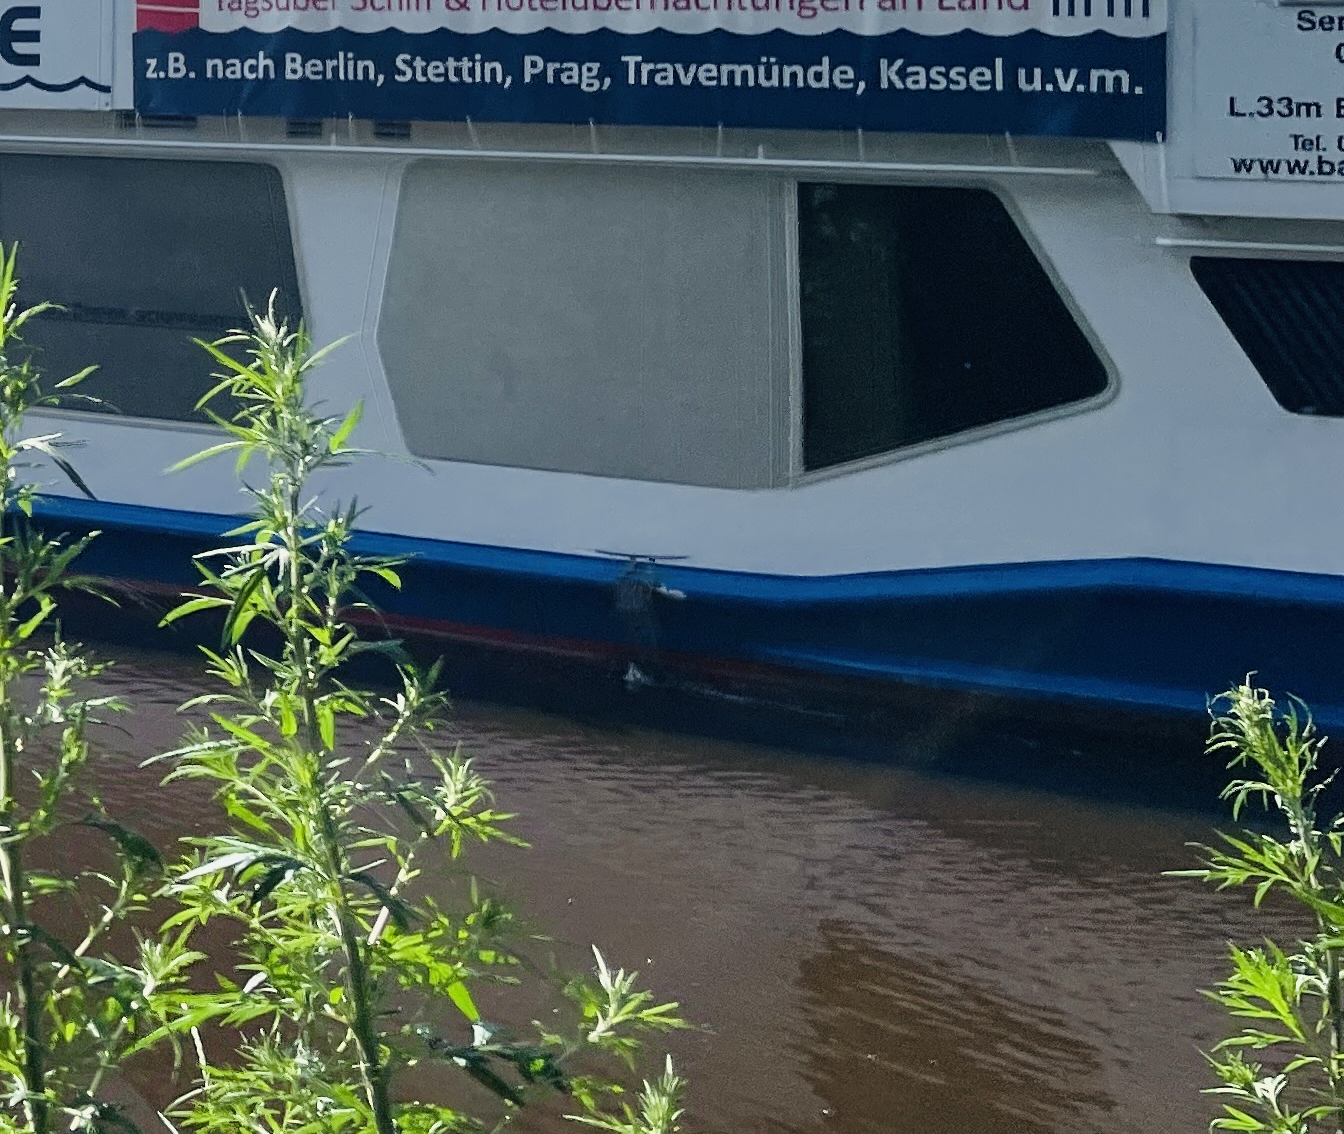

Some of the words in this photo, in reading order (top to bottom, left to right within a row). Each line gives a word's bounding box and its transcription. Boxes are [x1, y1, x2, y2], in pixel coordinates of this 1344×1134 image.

[145, 52, 197, 80] z.B.
[206, 50, 276, 81] nach
[284, 51, 386, 87] Berlin,
[394, 53, 513, 90] Stettin,
[523, 55, 612, 93] Prag,
[620, 55, 867, 96] Travemünde,
[879, 57, 1004, 92] Kassel
[1017, 66, 1144, 96] u.v.m.
[1228, 95, 1323, 118] L.33m
[1289, 133, 1328, 153] Tel.
